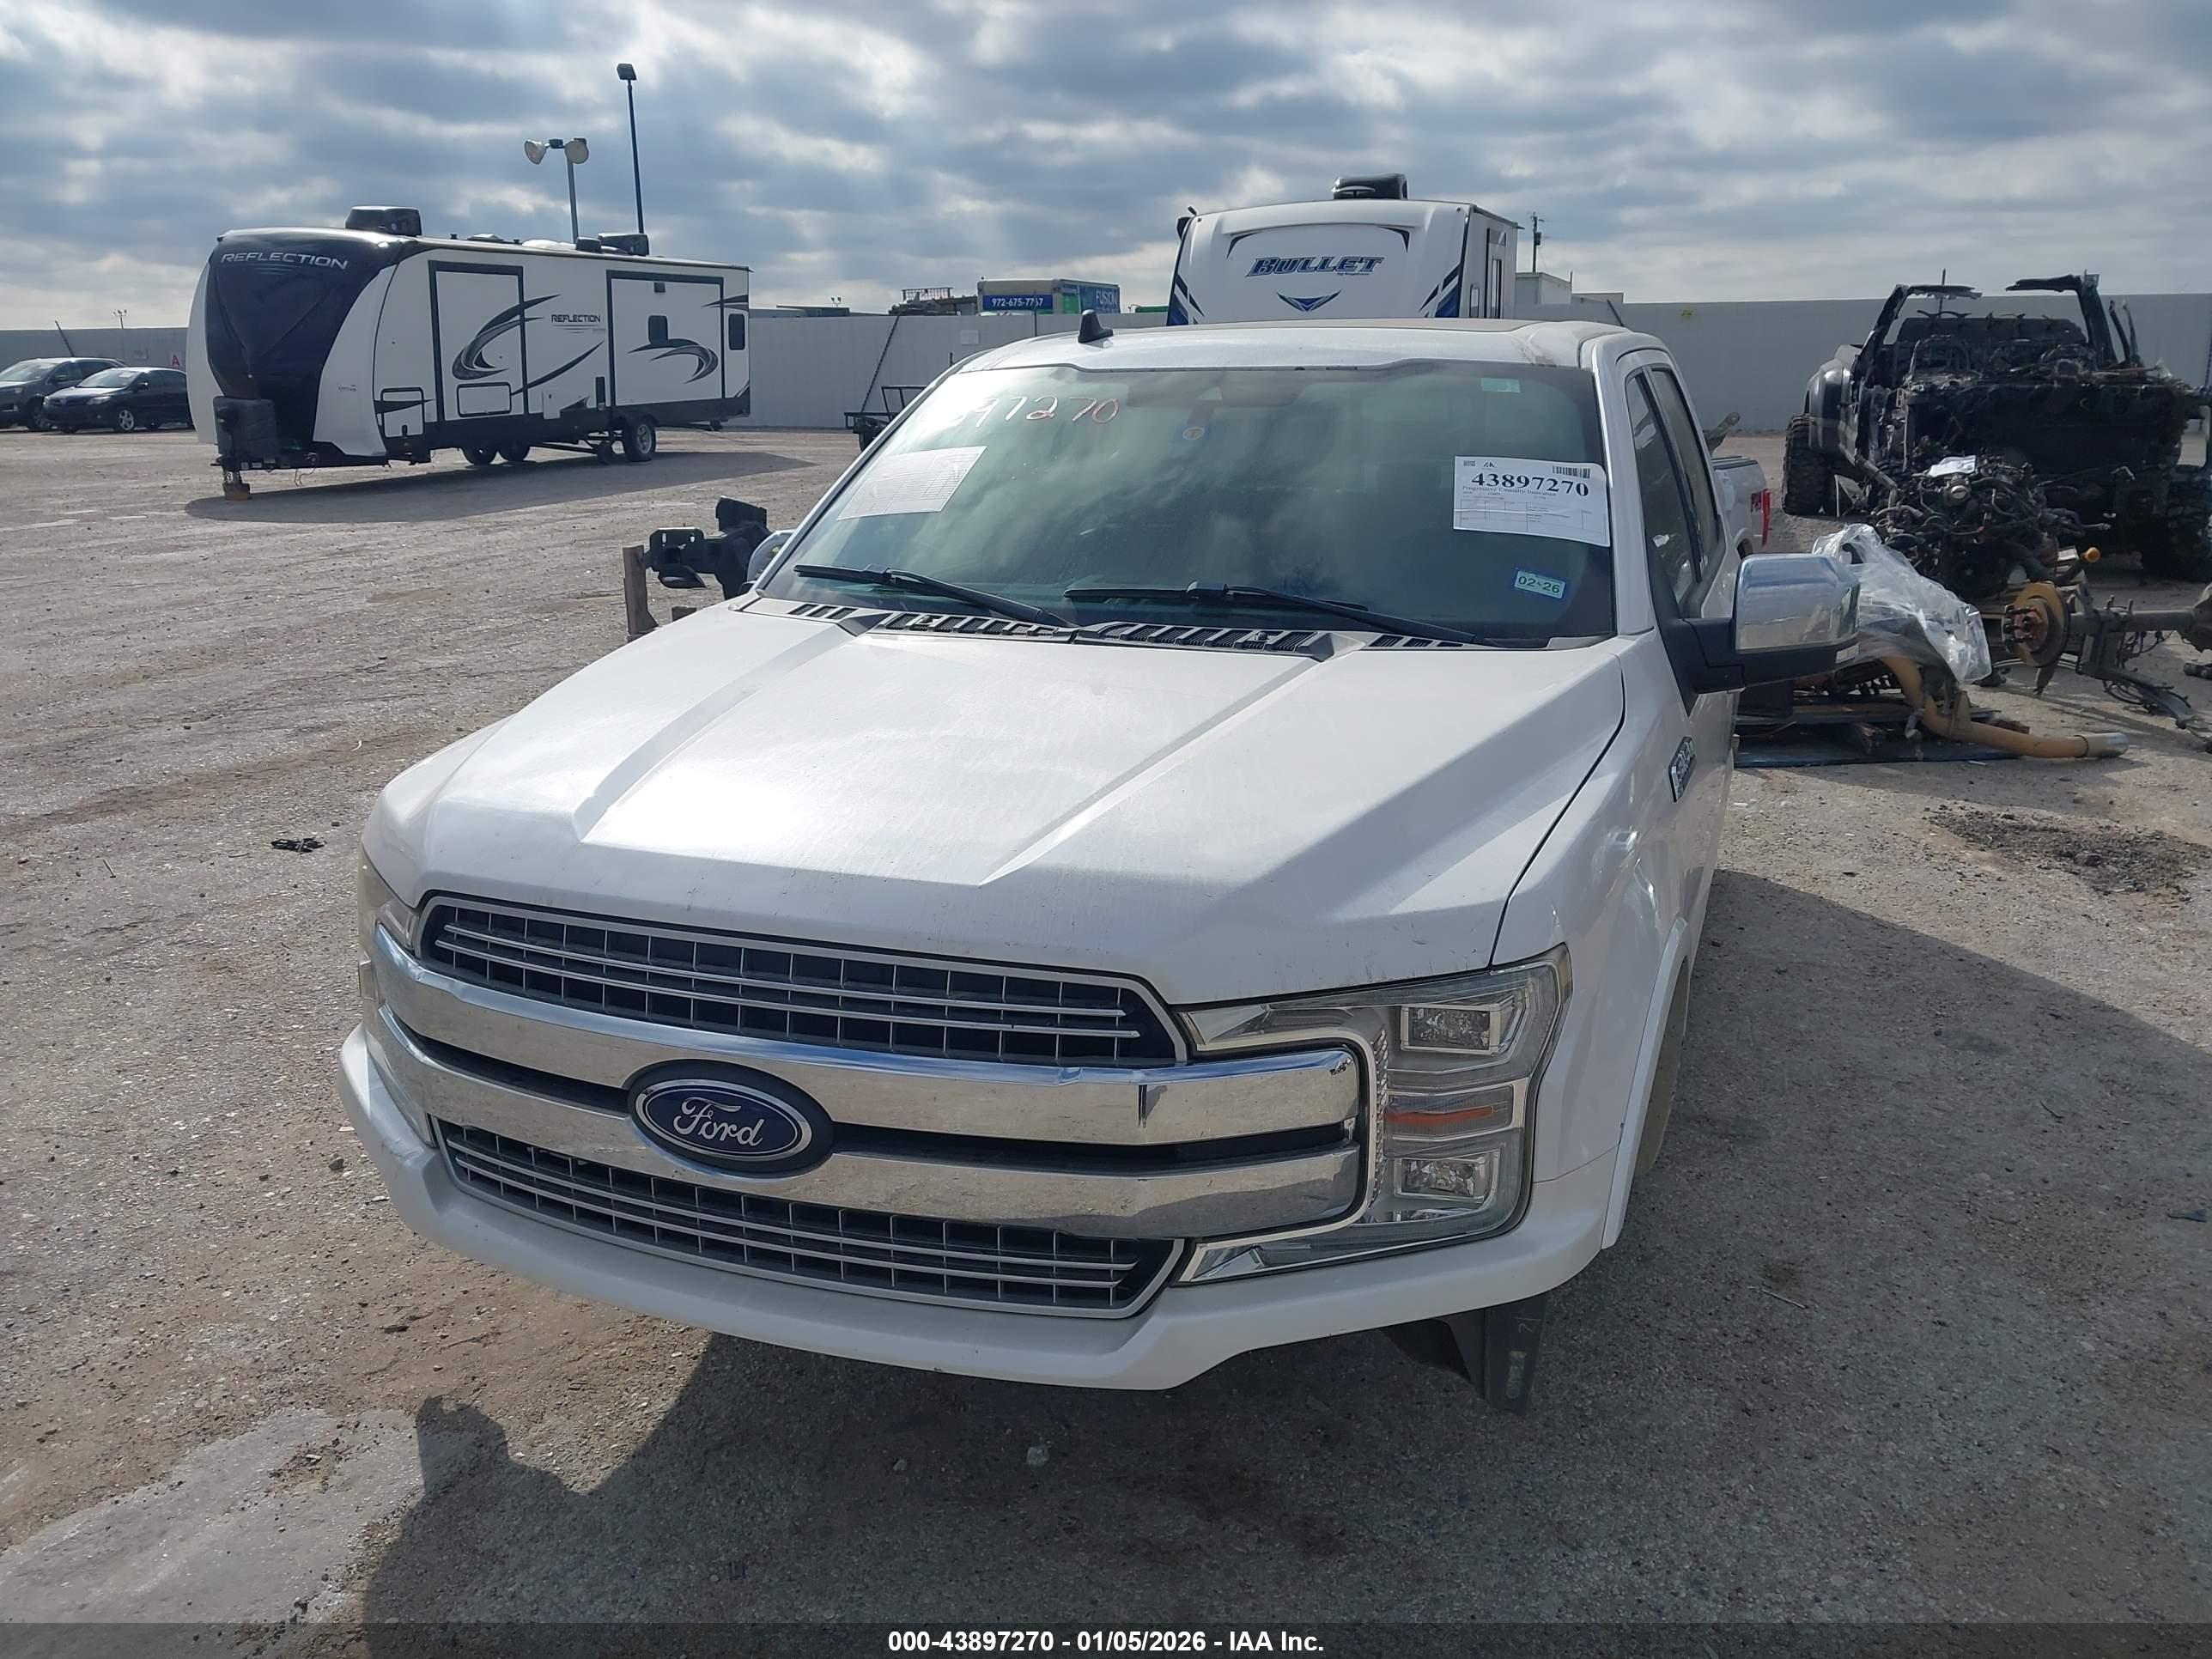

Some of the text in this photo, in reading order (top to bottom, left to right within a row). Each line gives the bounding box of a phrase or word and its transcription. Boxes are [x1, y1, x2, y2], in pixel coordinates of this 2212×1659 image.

[221, 252, 348, 270] REFLECTION
[1245, 257, 1384, 277] BULLET
[551, 314, 601, 323] REFLECTION
[1471, 473, 1589, 497] 43897270
[673, 1097, 763, 1146] Ford
